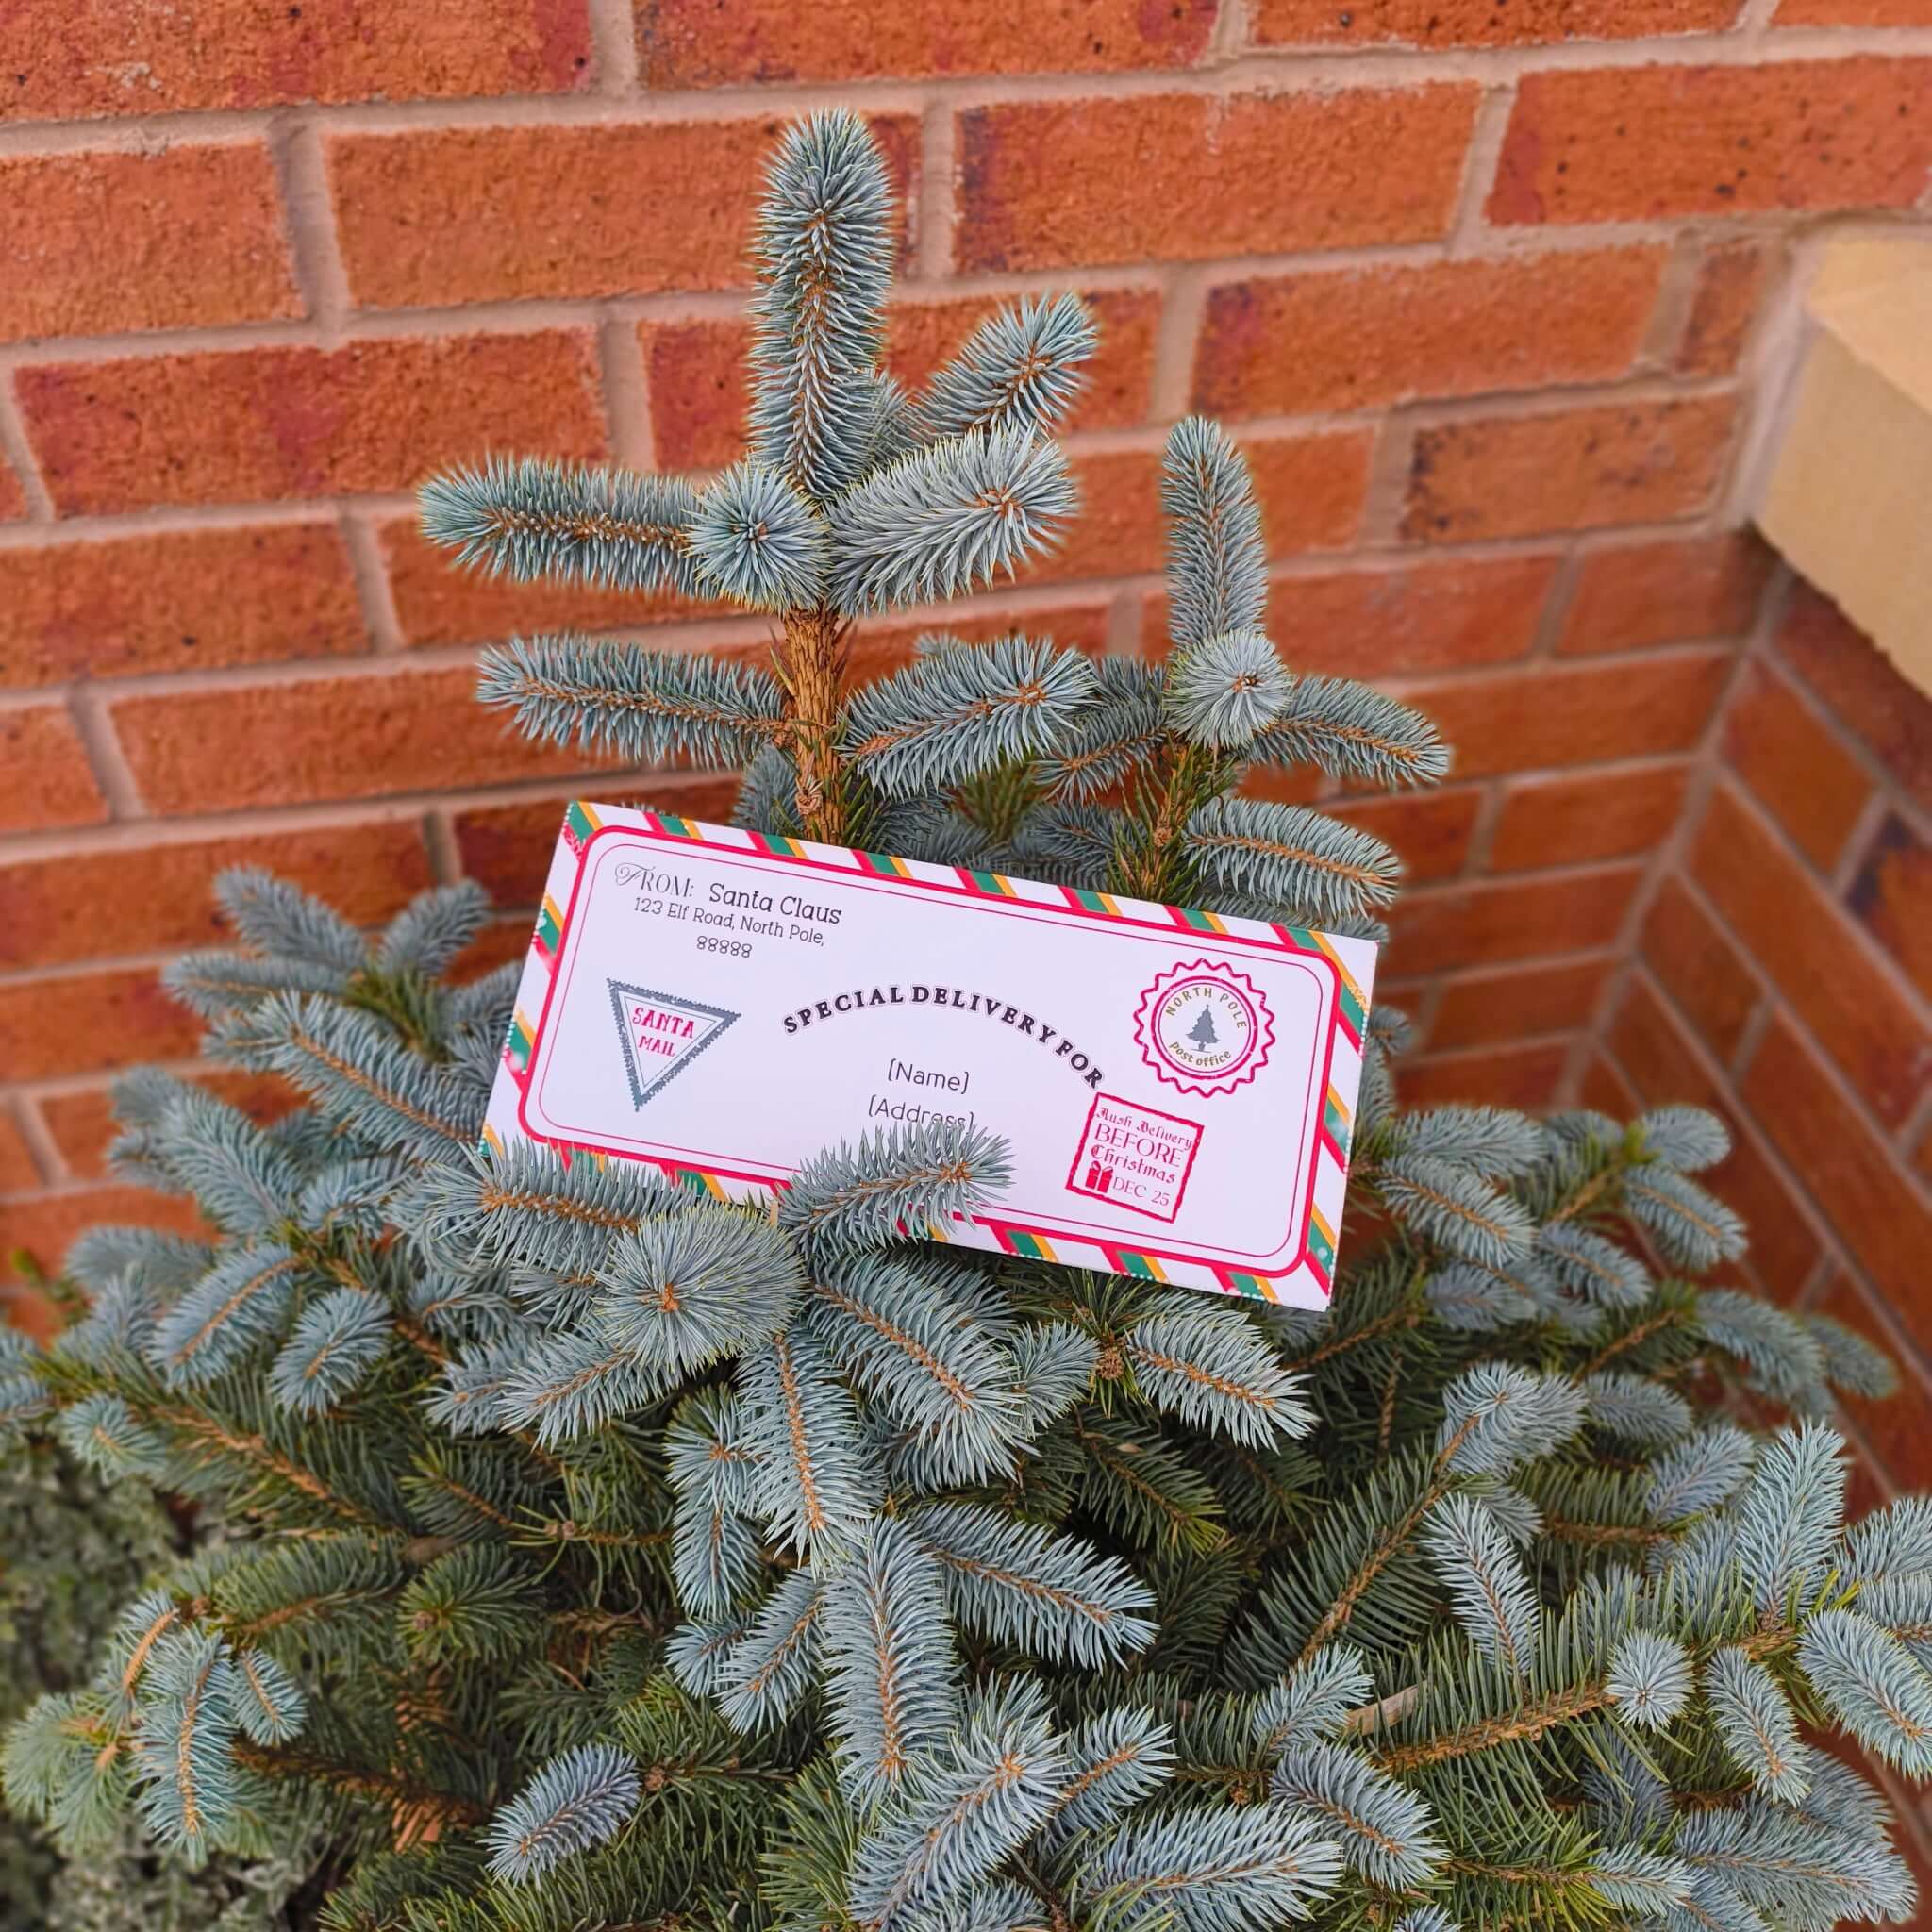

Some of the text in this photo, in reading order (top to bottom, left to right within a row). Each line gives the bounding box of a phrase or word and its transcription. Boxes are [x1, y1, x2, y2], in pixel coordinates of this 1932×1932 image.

[634, 897, 824, 947] 123 Elf Road, North Pole,
[708, 882, 773, 913] Santa
[780, 896, 841, 924] Claus
[696, 935, 753, 958] 88888
[632, 1006, 695, 1039] SANTA
[1165, 987, 1247, 1029] NORTH POLE
[638, 1035, 675, 1058] MAIL
[783, 986, 1104, 1089] SPECIAL DELIVERY FOR
[1195, 1050, 1232, 1067] office
[1094, 1123, 1185, 1168] BEFORE
[1096, 1107, 1193, 1152] Rush Delivery
[1091, 1144, 1177, 1185] Christmas
[1112, 1176, 1172, 1207] DEC 25
